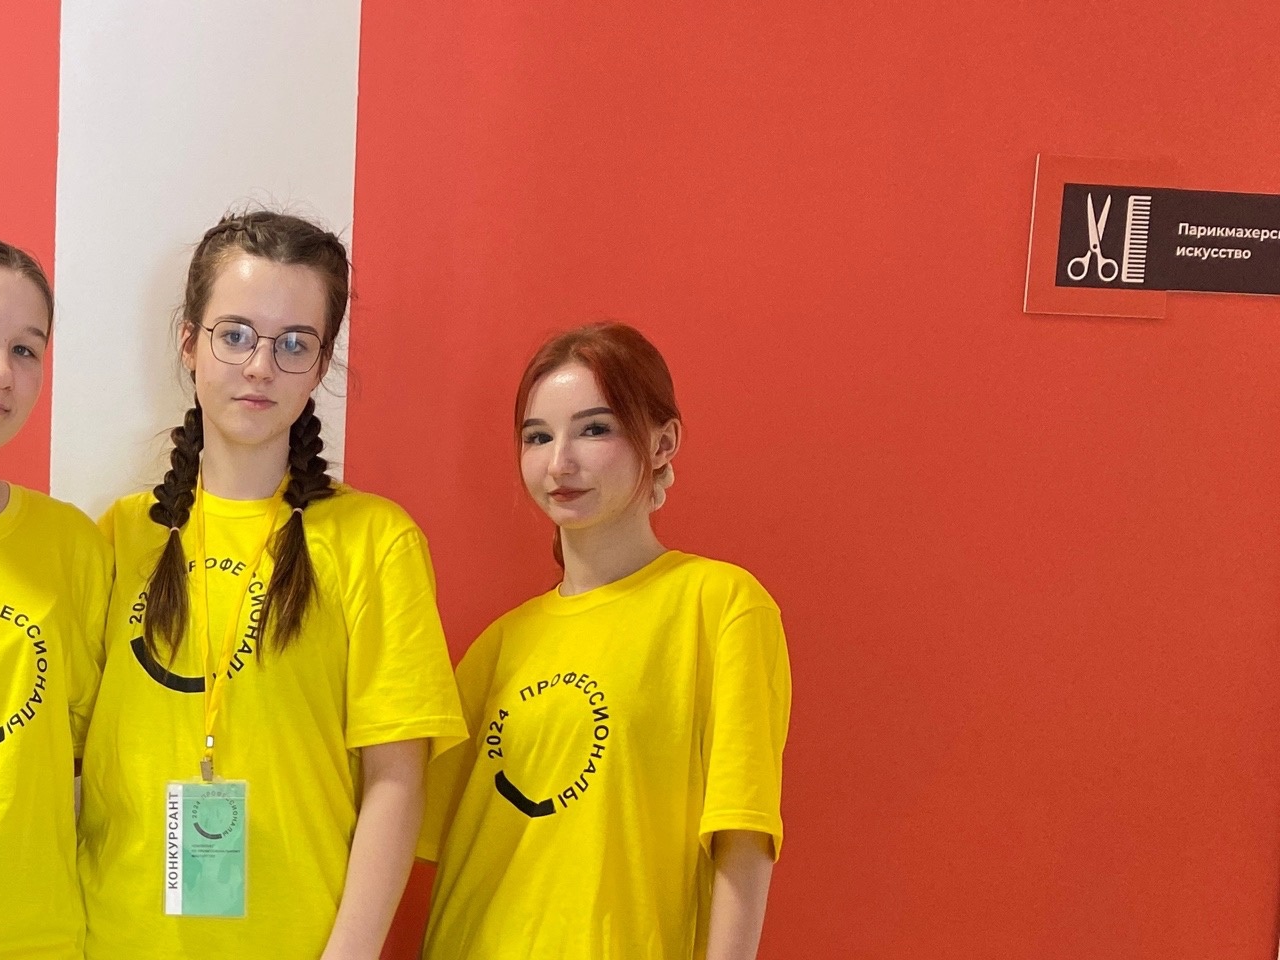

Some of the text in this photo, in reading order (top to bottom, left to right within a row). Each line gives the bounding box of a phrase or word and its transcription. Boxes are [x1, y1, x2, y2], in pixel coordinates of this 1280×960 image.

[1176, 246, 1252, 260] искусство
[188, 557, 266, 680] РОФЕСИОНАЛ
[486, 671, 610, 808] 2024 ПРОФЕССИОНАЛЫ
[168, 791, 179, 890] КОНКУРСАНТ
